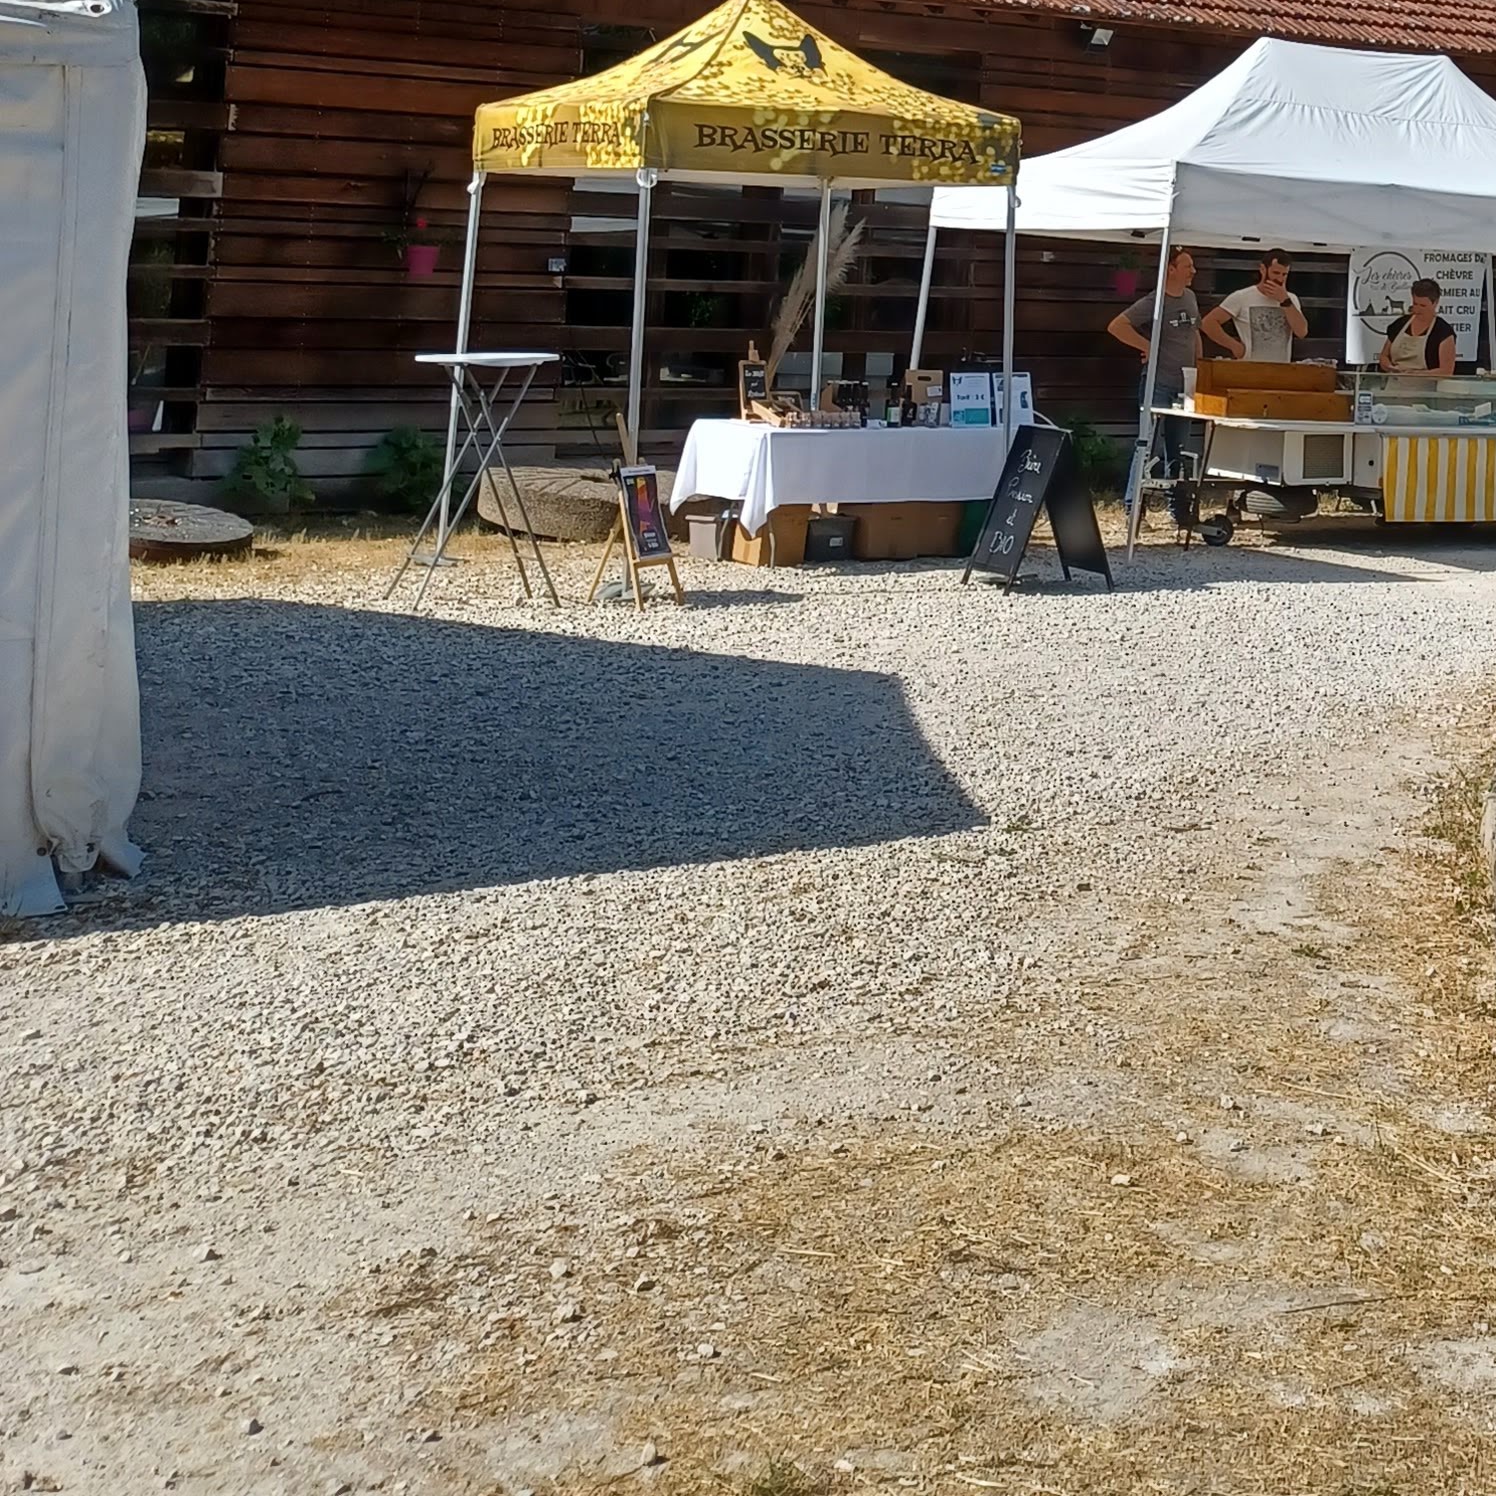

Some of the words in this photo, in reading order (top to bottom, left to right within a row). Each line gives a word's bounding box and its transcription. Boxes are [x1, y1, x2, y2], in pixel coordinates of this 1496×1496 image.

[491, 121, 569, 151] BRASSERIE
[571, 121, 622, 147] TERRA
[693, 123, 870, 158] BRASSERIE
[878, 133, 982, 165] TERRA
[1423, 253, 1473, 263] FROMAGES
[1436, 269, 1473, 280] CHÈVRE
[1469, 288, 1481, 298] AU
[1438, 305, 1454, 315] AIT
[1456, 305, 1476, 315] CRU
[989, 531, 1014, 554] BIO
